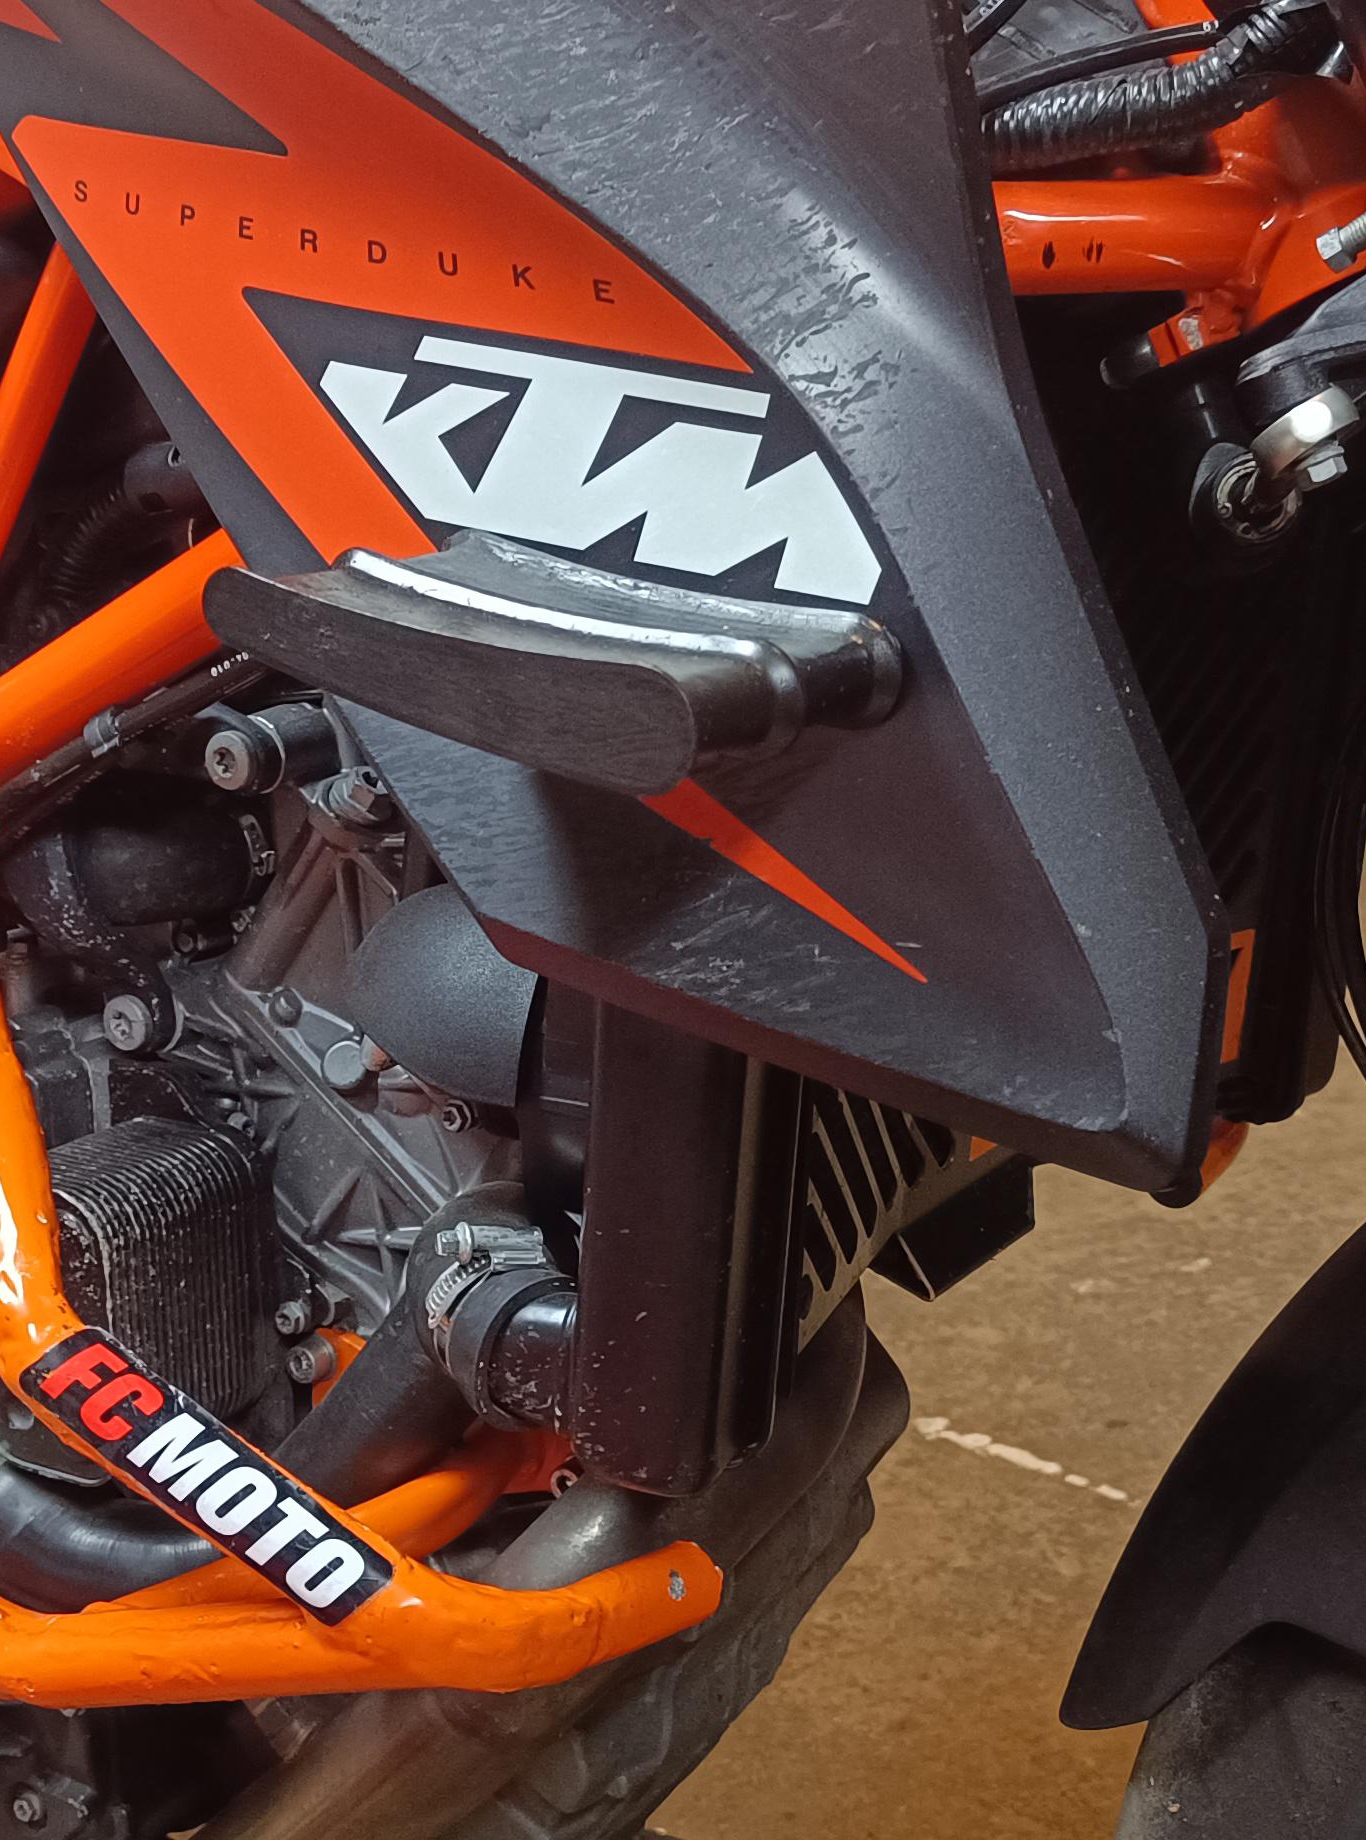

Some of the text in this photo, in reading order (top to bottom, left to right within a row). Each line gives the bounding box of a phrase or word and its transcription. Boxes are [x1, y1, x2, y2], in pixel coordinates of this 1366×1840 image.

[73, 180, 616, 304] SUPERDUKE
[319, 335, 883, 605] KTM
[38, 1342, 366, 1609] FC MOTO
